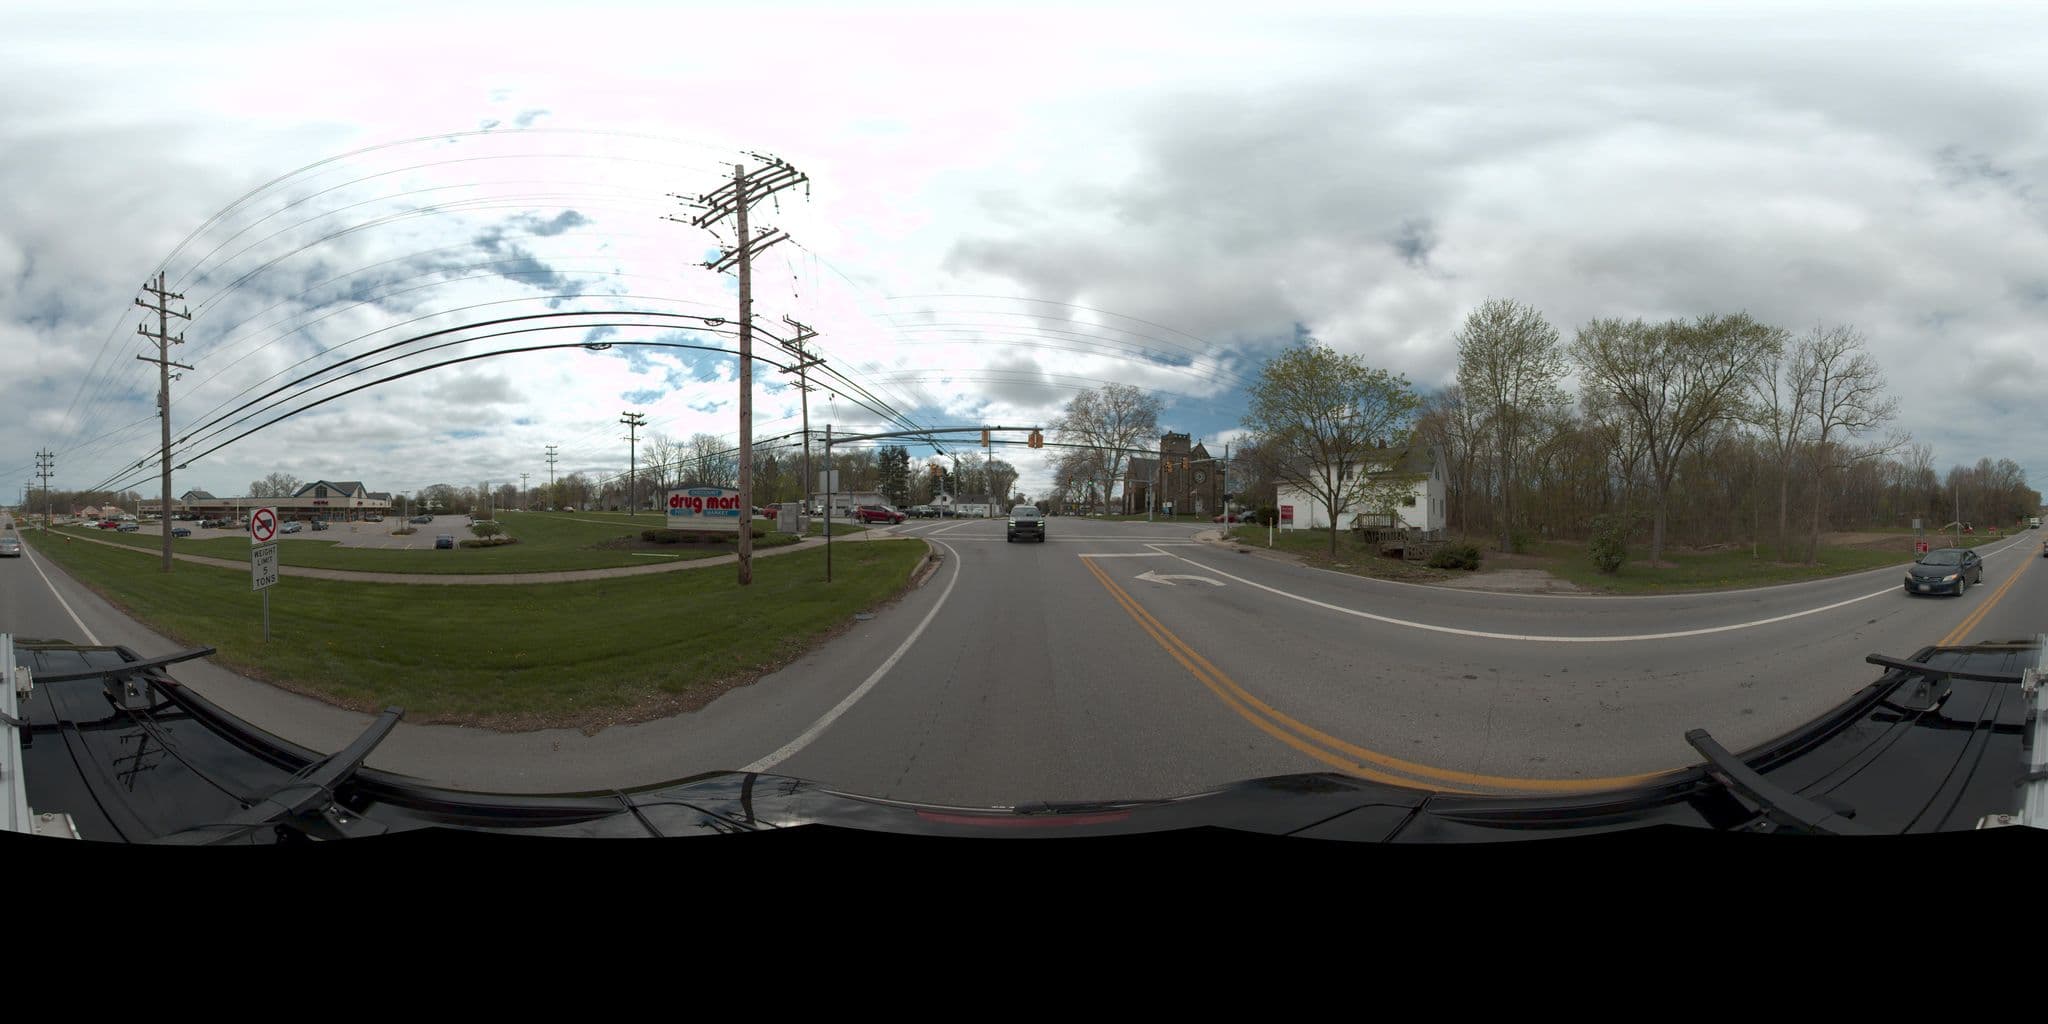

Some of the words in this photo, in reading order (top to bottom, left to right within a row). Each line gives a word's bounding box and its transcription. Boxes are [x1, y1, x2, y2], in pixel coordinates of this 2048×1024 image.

[670, 494, 702, 513] drug
[706, 494, 740, 509] mart
[254, 546, 276, 558] WEIGHT
[257, 556, 273, 566] LIMIT
[263, 566, 268, 575] 5
[256, 574, 276, 586] TONS
